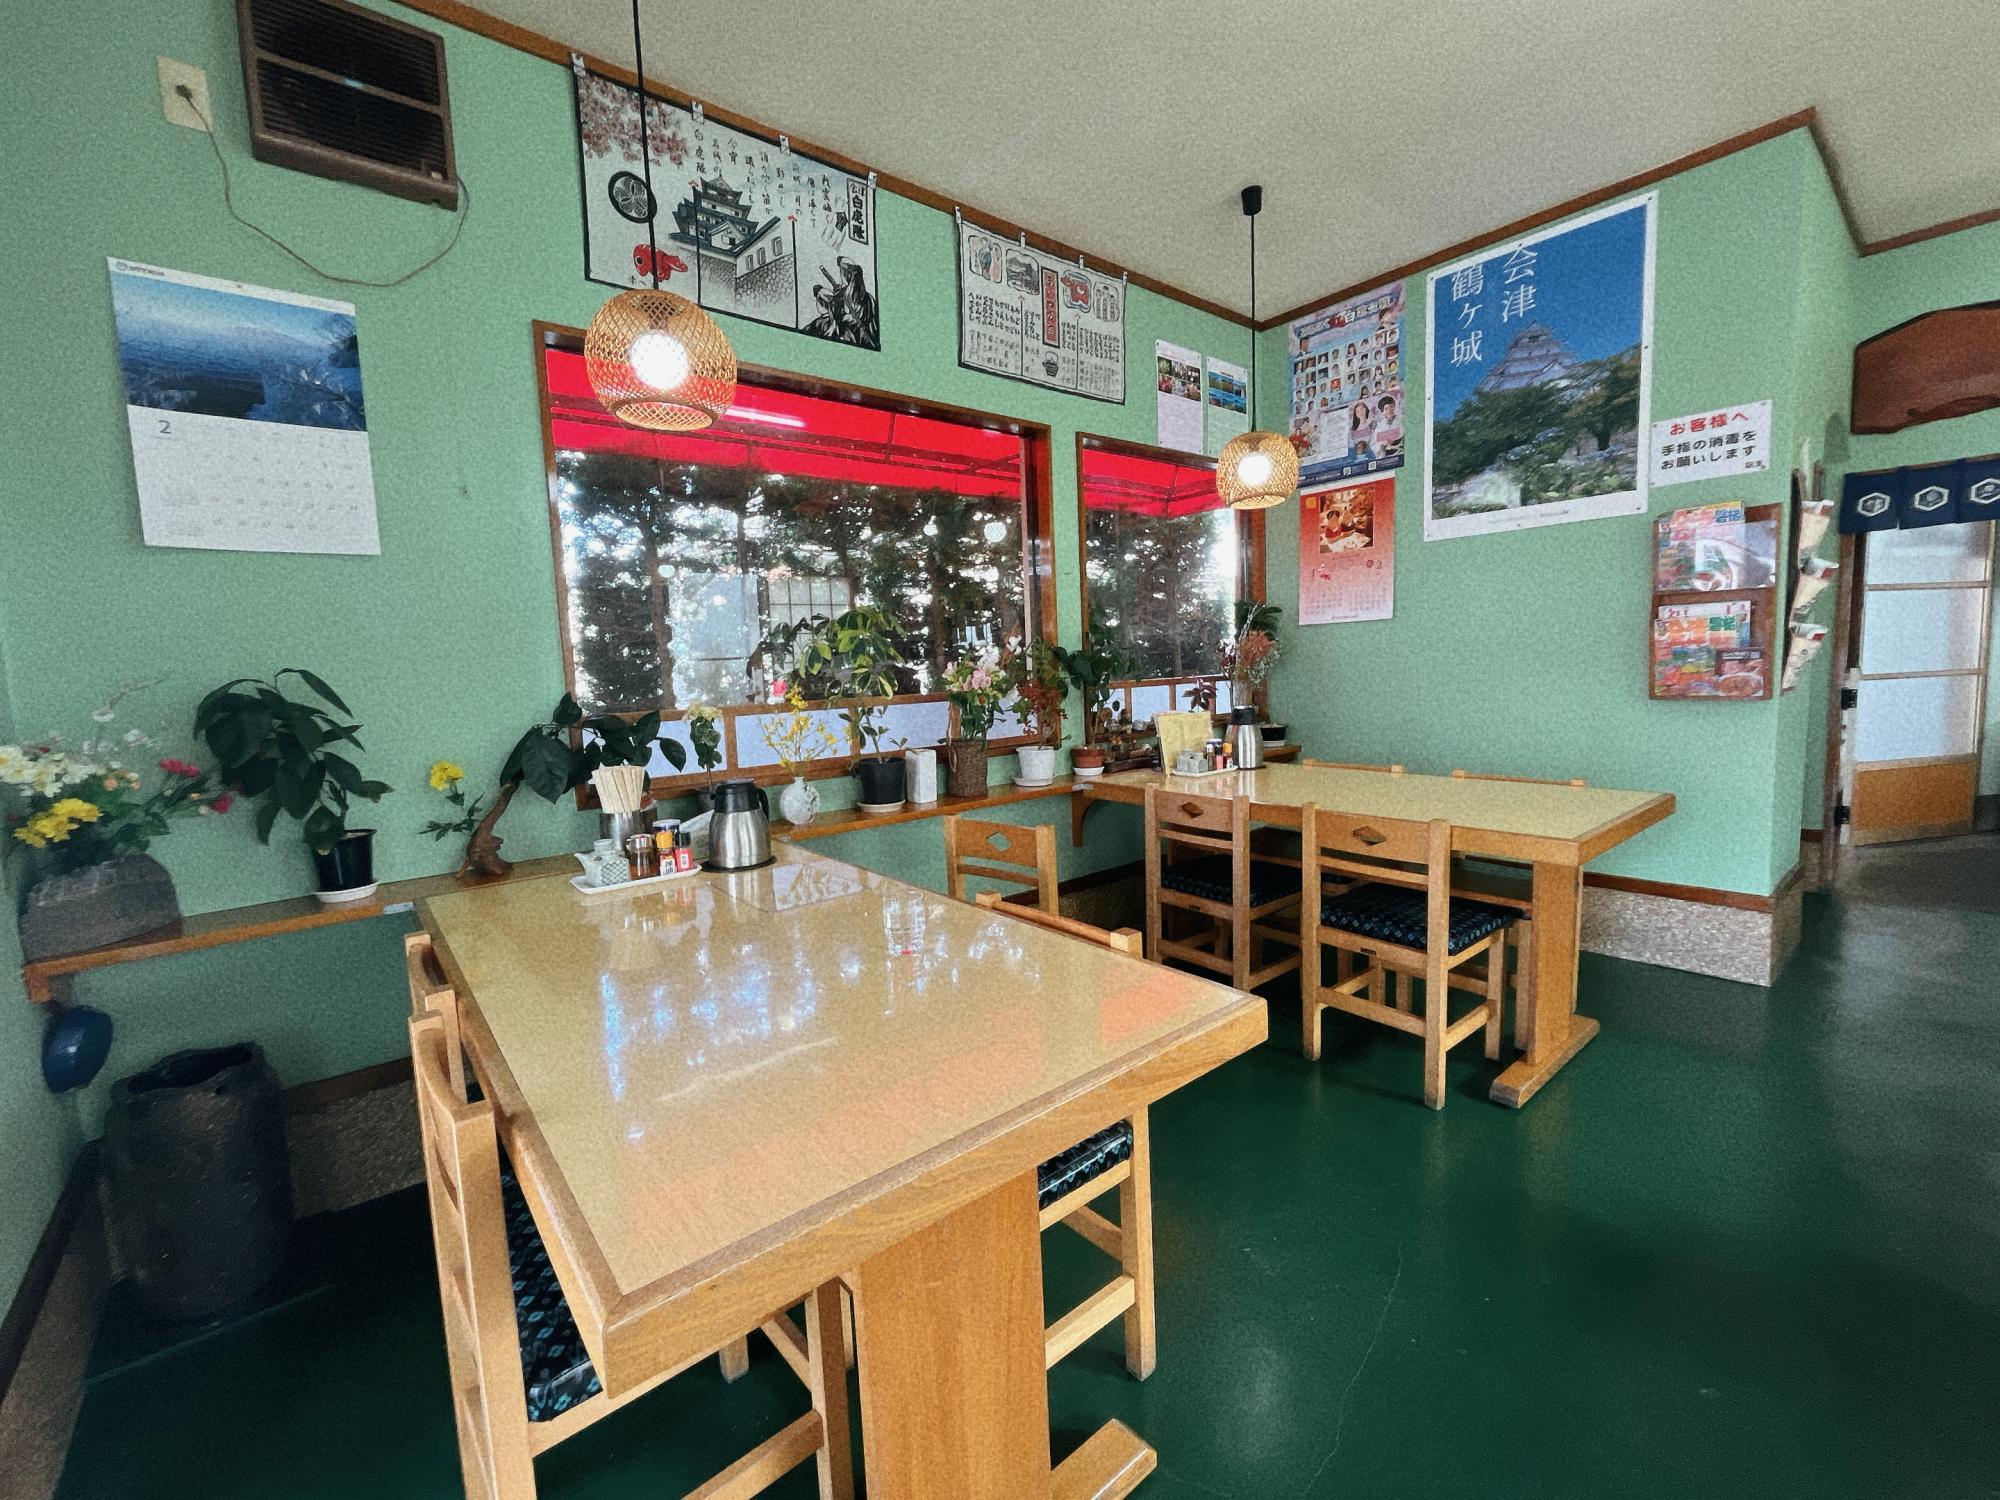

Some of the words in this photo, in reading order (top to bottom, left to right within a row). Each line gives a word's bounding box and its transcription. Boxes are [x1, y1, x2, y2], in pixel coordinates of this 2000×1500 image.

[693, 128, 707, 175] 白虎隊
[852, 194, 866, 240] 白虎隊
[1502, 246, 1538, 323] 会津
[159, 419, 172, 434] 2
[1670, 412, 1749, 436] お客様へ
[1661, 430, 1757, 457] 手指の消毒を
[1661, 445, 1757, 471] お願いします
